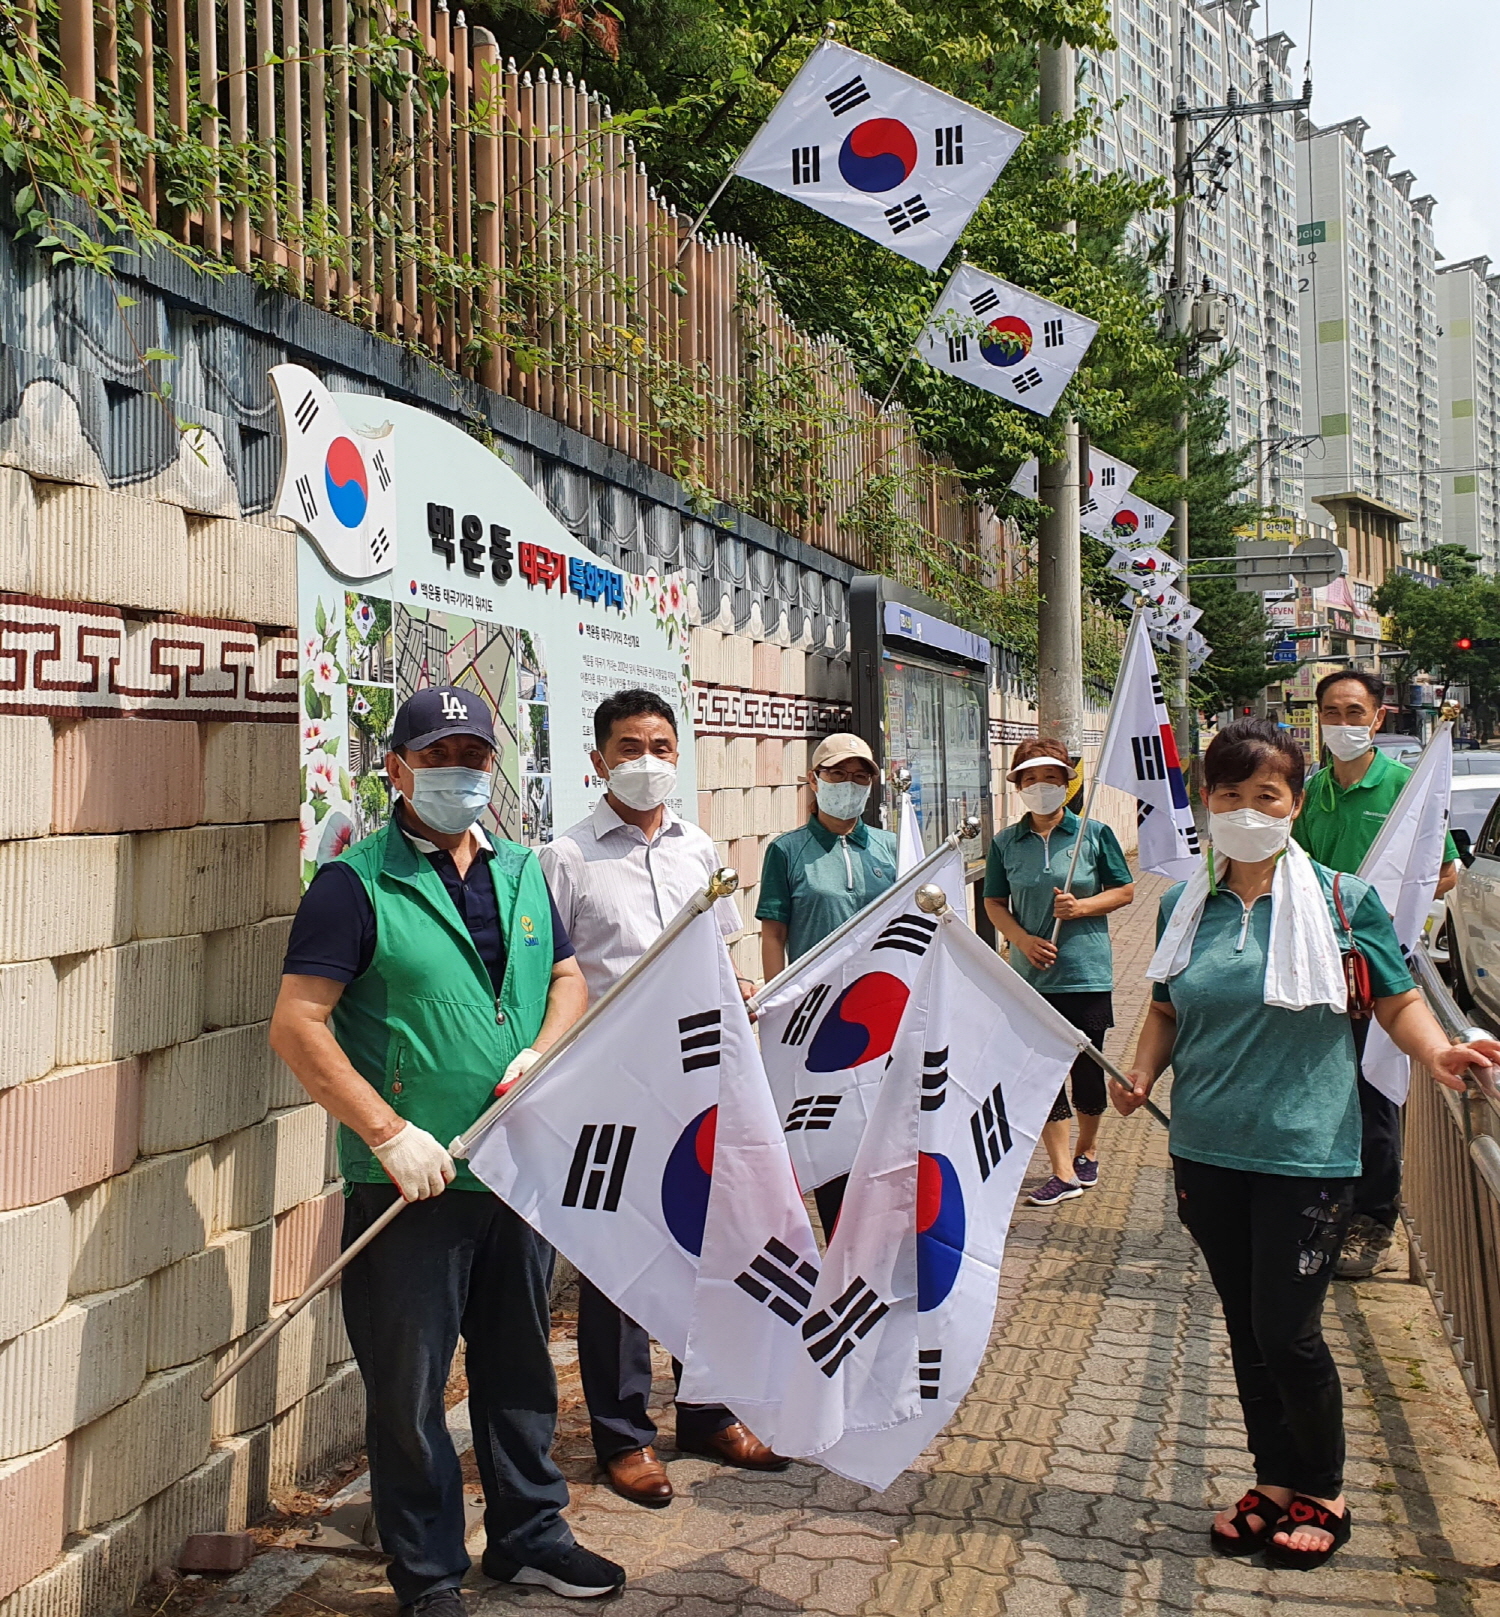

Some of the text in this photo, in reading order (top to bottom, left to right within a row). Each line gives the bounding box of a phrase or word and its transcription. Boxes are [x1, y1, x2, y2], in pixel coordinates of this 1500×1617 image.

[427, 502, 623, 610] 백운동 태극기 특화거리
[420, 583, 493, 613] 백운동 태극기거리 위치도
[586, 624, 640, 648] 백운동 태극기거리 조성개요
[439, 691, 469, 720] LA
